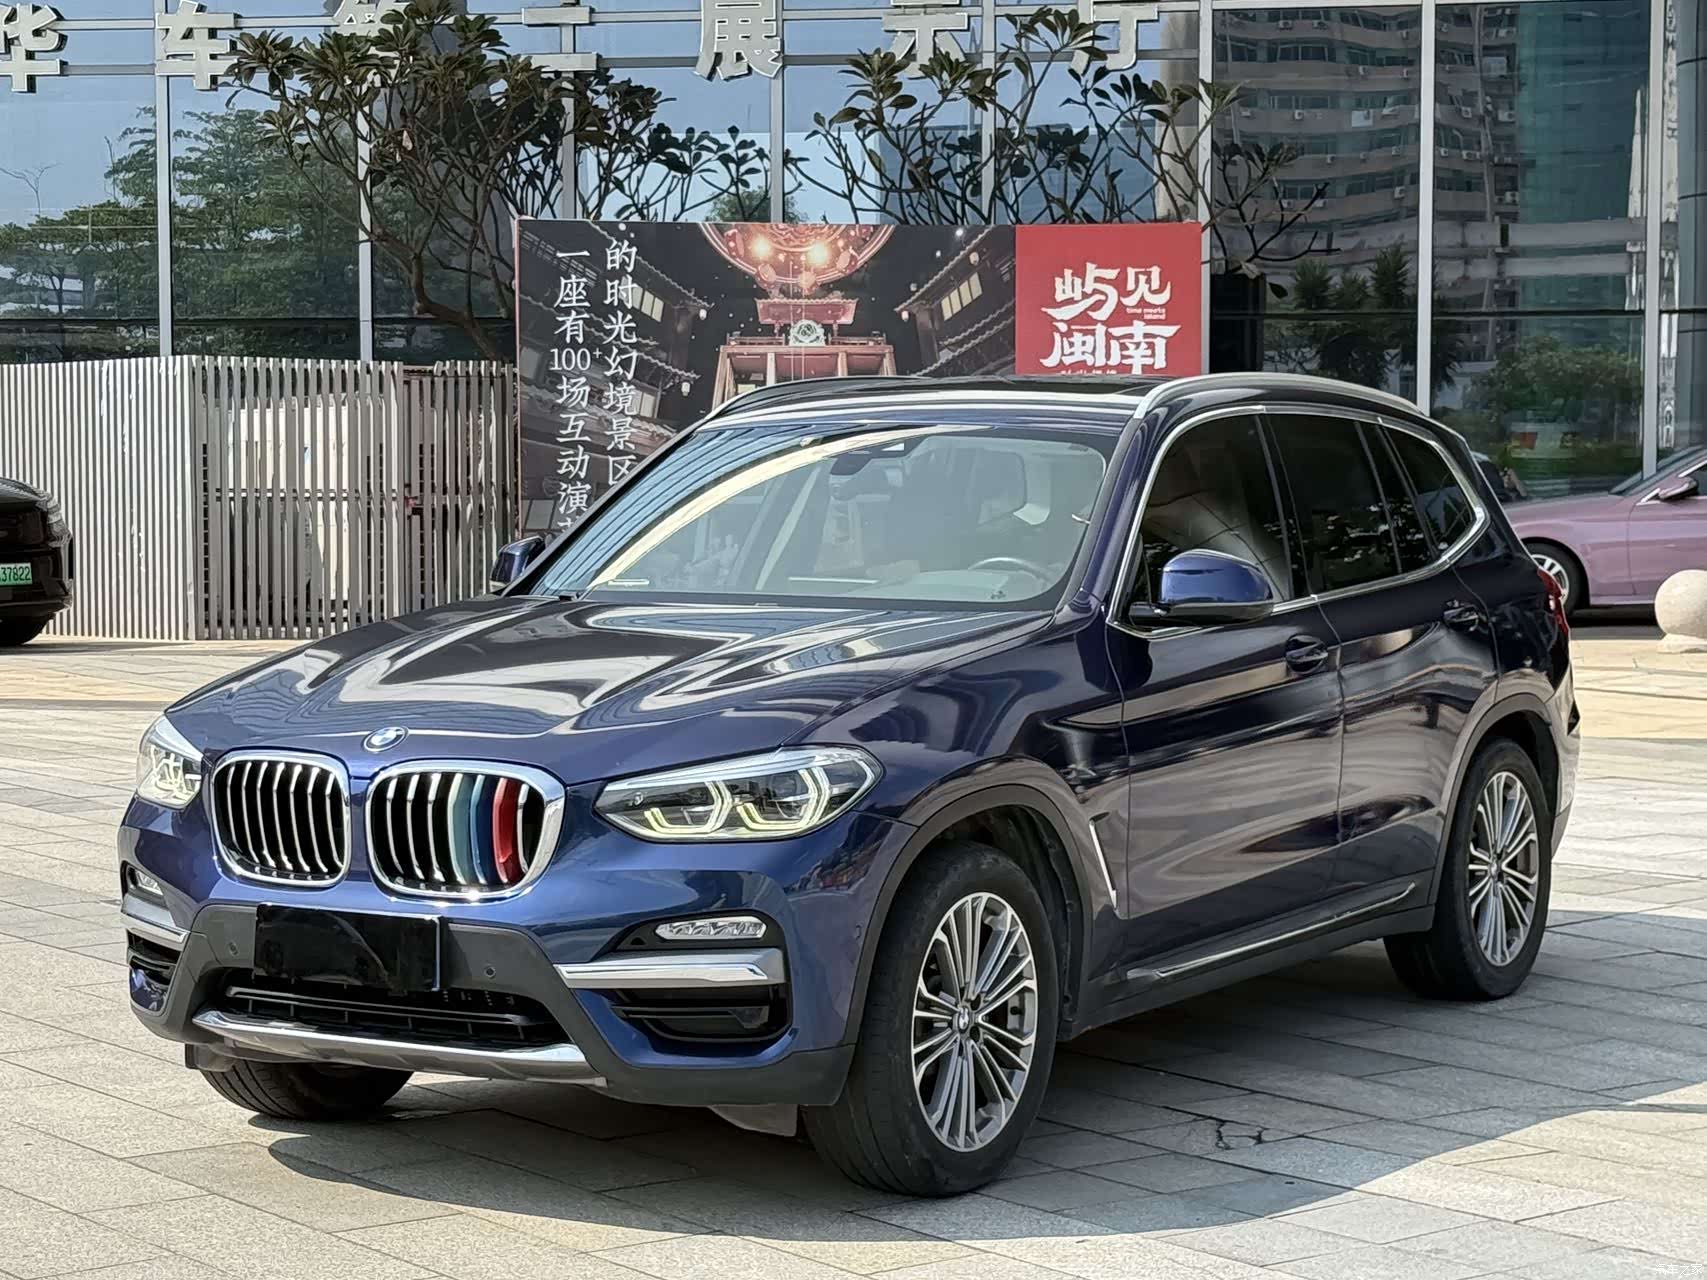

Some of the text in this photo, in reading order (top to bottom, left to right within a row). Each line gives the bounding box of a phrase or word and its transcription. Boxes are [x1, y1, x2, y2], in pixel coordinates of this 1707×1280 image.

[1040, 262, 1172, 321] 屿见
[602, 238, 639, 486] 的时光幻境景区
[1040, 319, 1182, 375] 闽南
